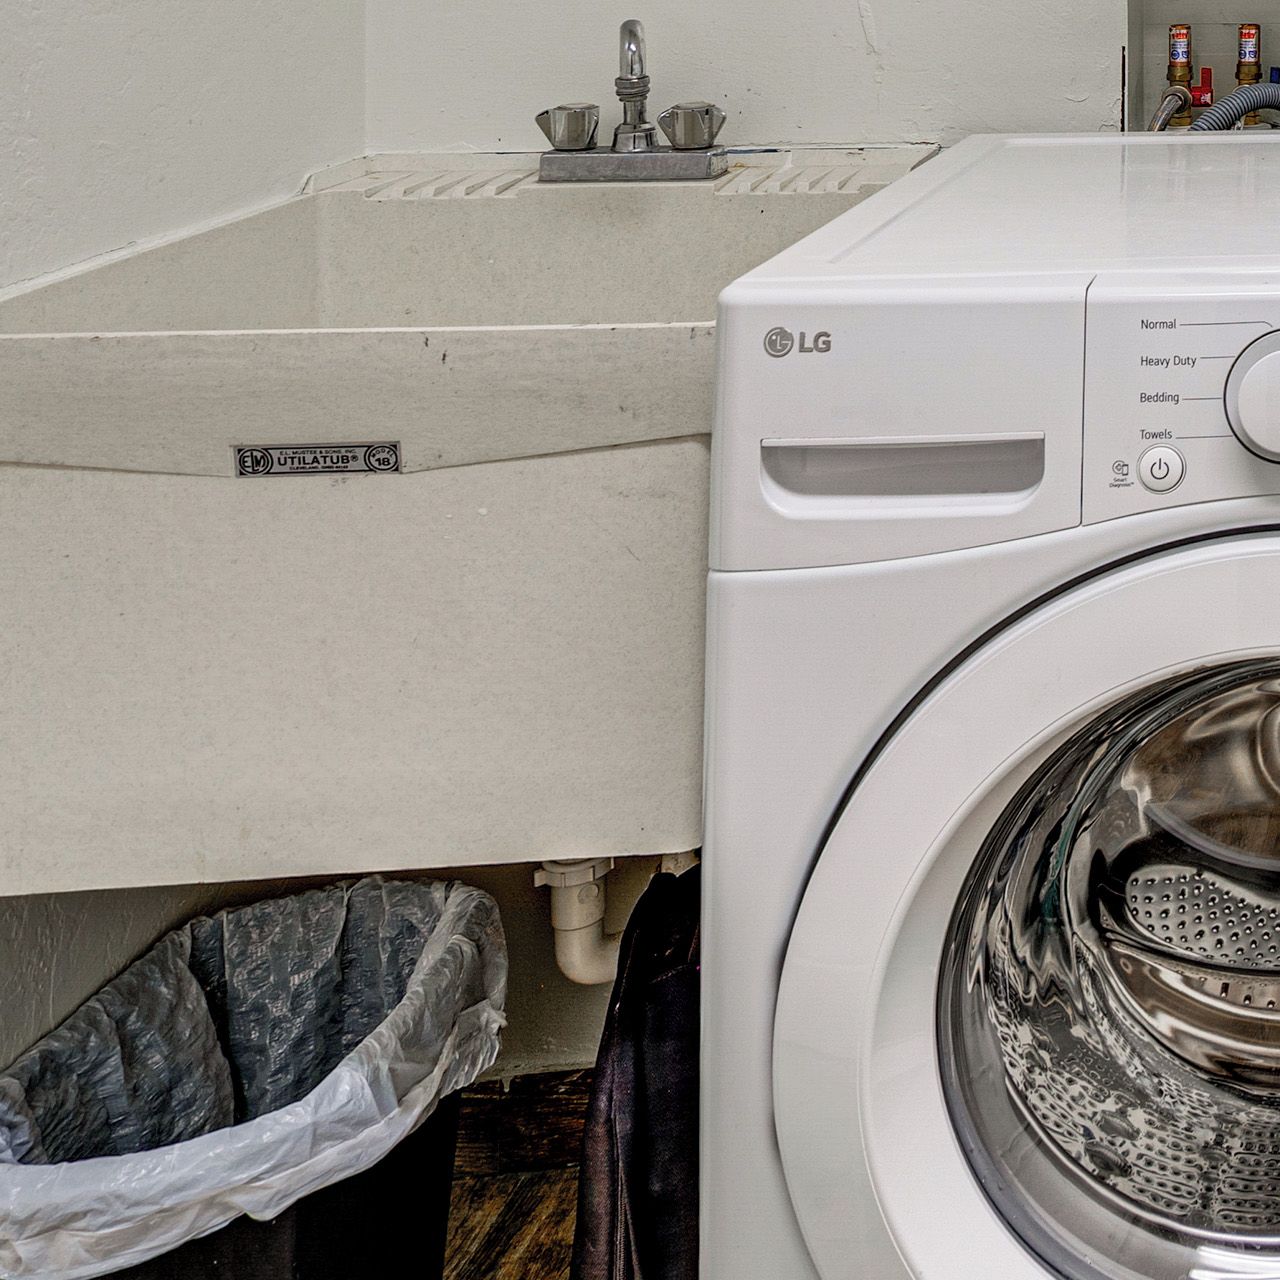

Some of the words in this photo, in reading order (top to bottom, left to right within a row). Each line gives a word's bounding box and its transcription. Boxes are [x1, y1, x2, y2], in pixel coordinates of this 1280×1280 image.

[1140, 318, 1177, 330] Normal
[798, 331, 832, 353] LG
[1140, 355, 1171, 369] Heavy
[1174, 354, 1197, 368] Duty
[1139, 391, 1180, 405] Bedding
[1140, 428, 1173, 440] Towels
[370, 448, 394, 458] MODEL
[375, 457, 391, 467] 18
